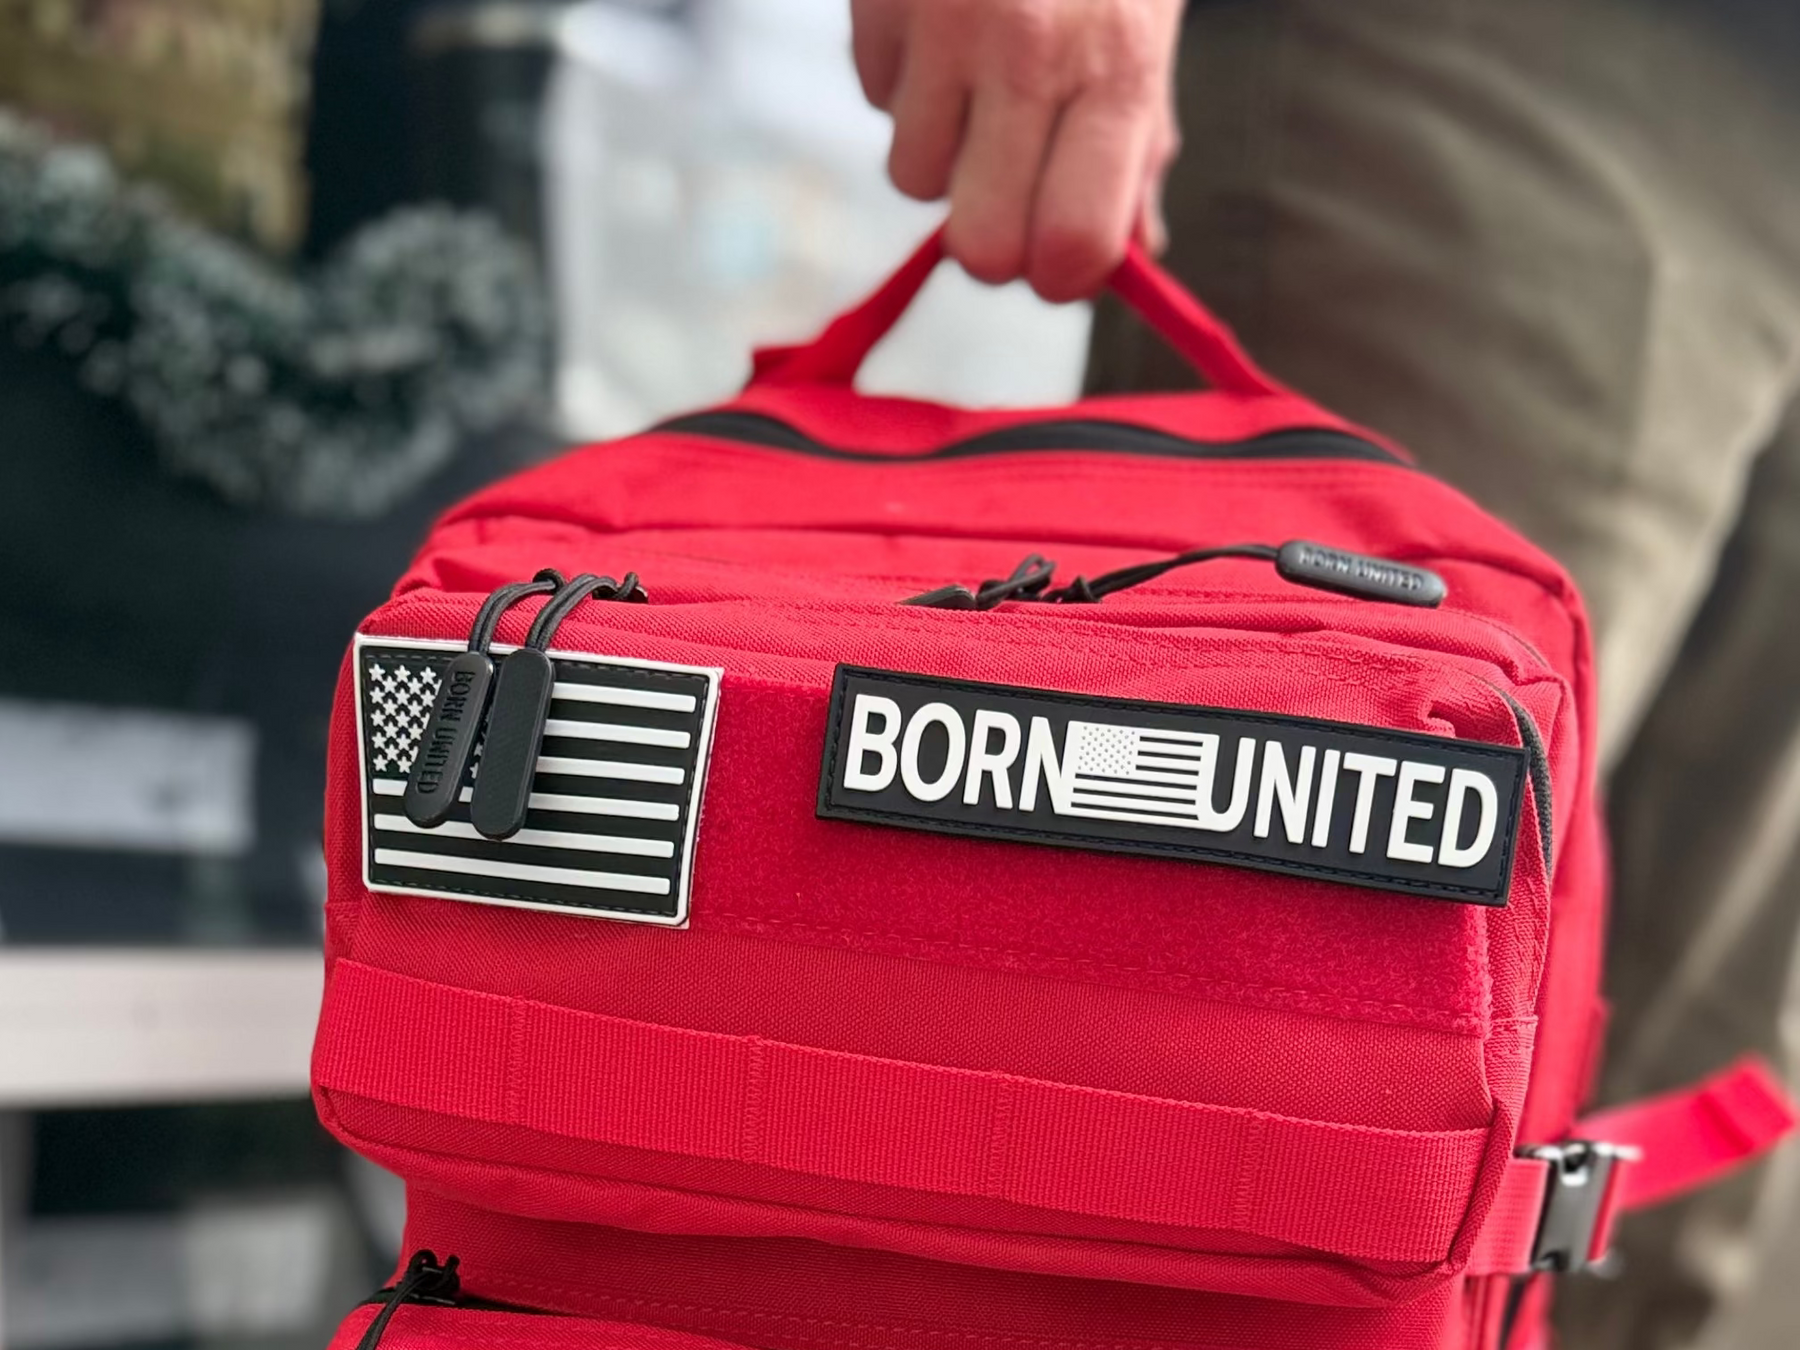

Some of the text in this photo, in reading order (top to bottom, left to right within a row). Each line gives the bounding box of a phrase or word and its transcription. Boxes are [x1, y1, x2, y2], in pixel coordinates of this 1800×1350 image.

[1299, 547, 1425, 592] BORN UNITED
[414, 671, 476, 794] BORN UNITED
[844, 694, 1499, 869] BORN UNITED
